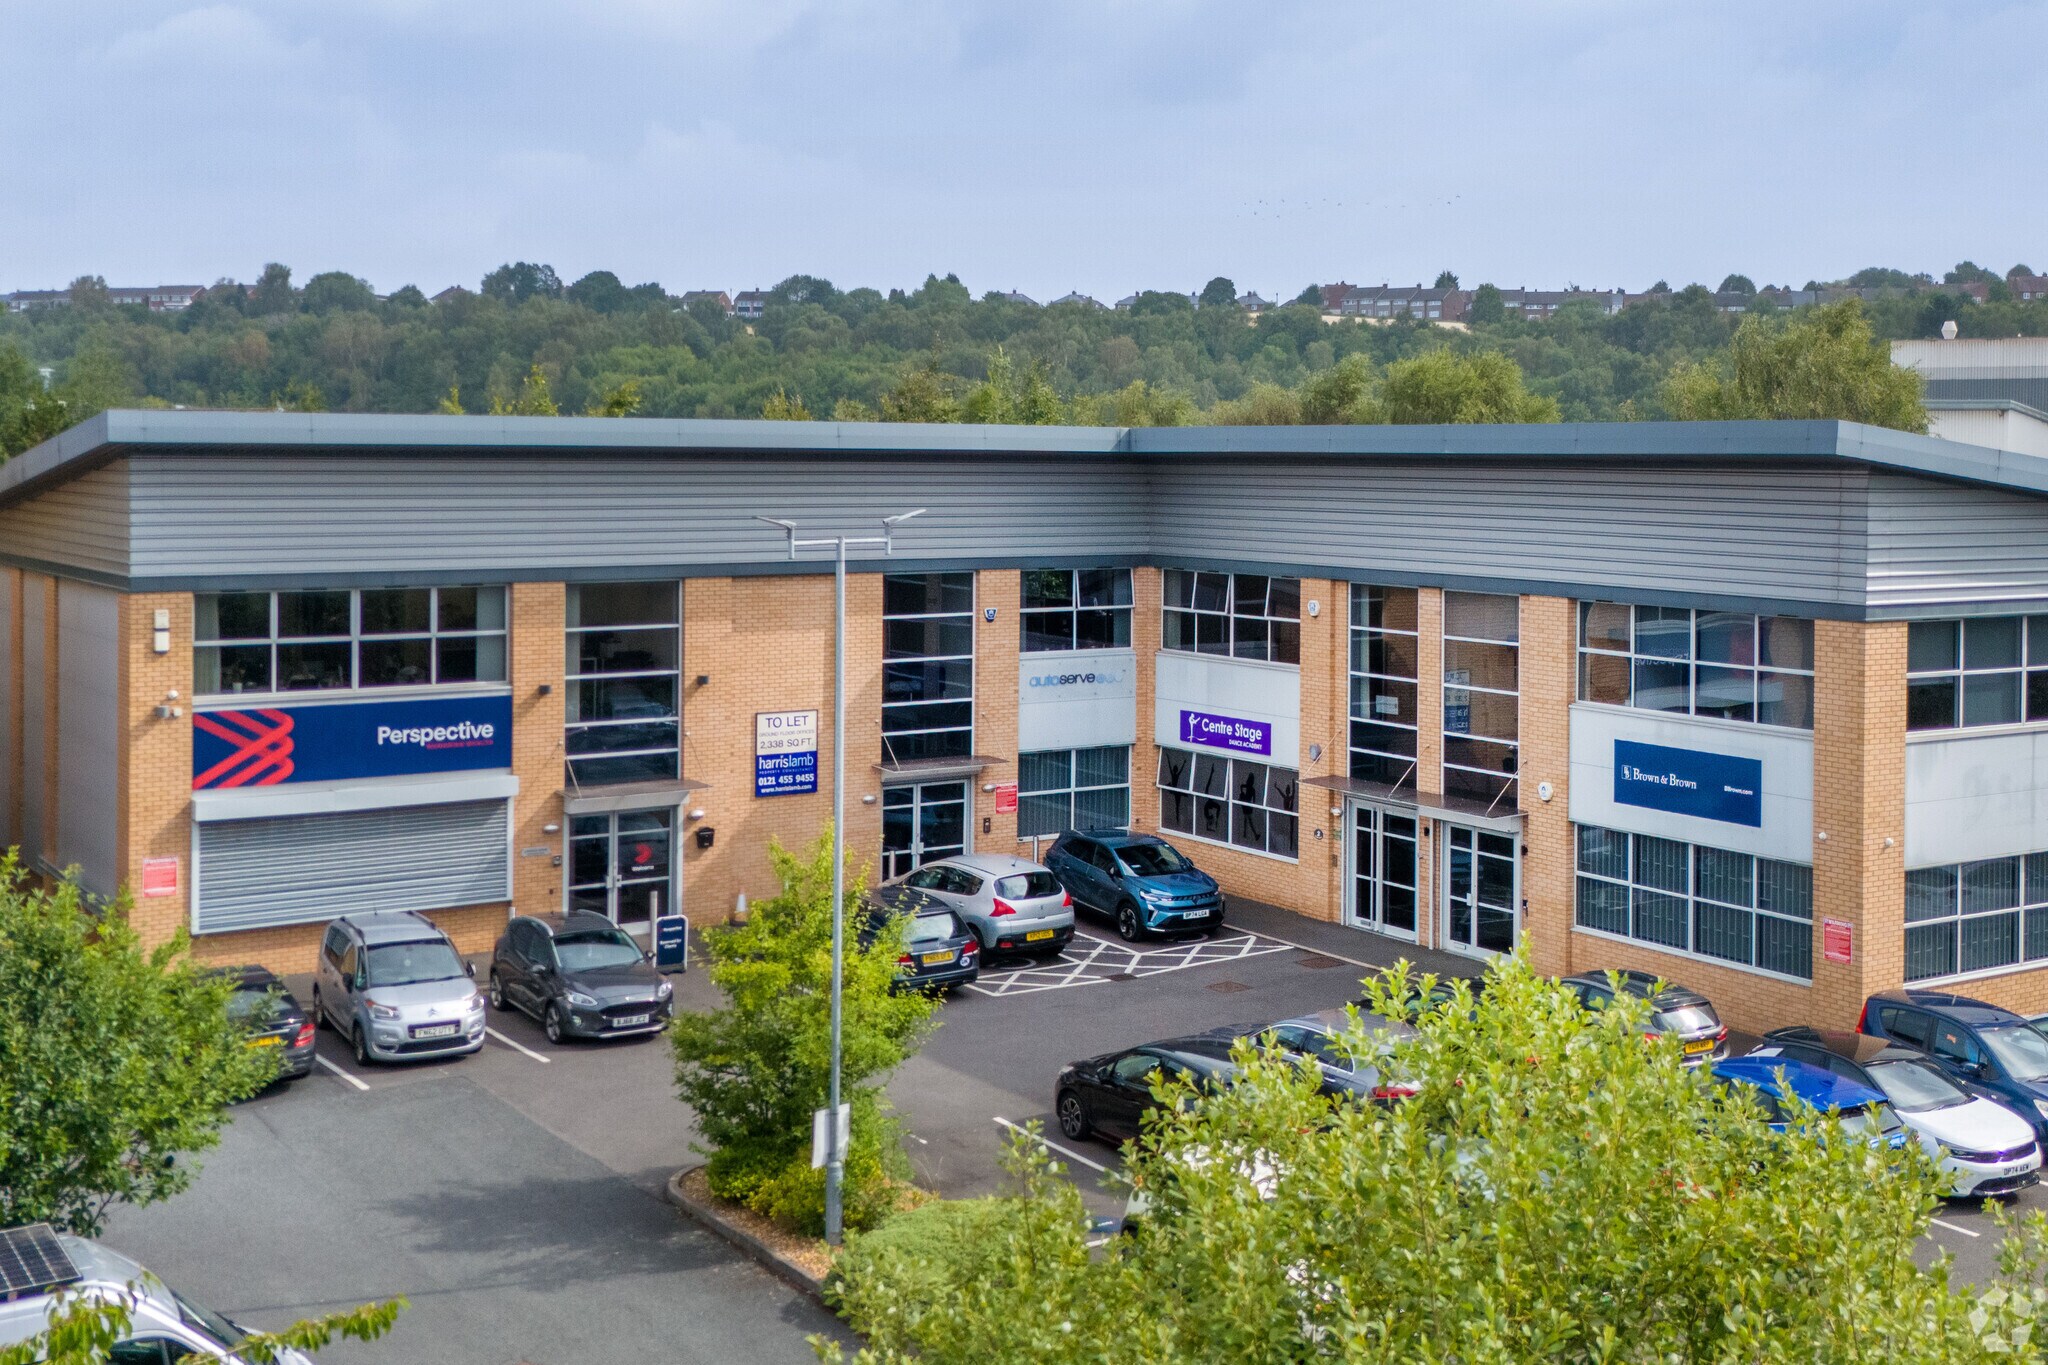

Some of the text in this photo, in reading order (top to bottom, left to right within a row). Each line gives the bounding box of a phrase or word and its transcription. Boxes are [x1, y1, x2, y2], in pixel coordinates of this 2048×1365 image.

[765, 715, 809, 728] TO LET
[377, 720, 494, 747] Perspective
[1201, 718, 1263, 742] Centre Stage
[787, 738, 800, 748] SQ
[1229, 739, 1263, 750] DANCE ACADEMY
[758, 753, 814, 770] harrislamb
[758, 773, 815, 786] 0121 455 9455
[1633, 767, 1660, 784] Brown
[1660, 774, 1668, 785] &
[1669, 773, 1697, 790] Brown
[761, 784, 812, 794] www.harrislamb.com
